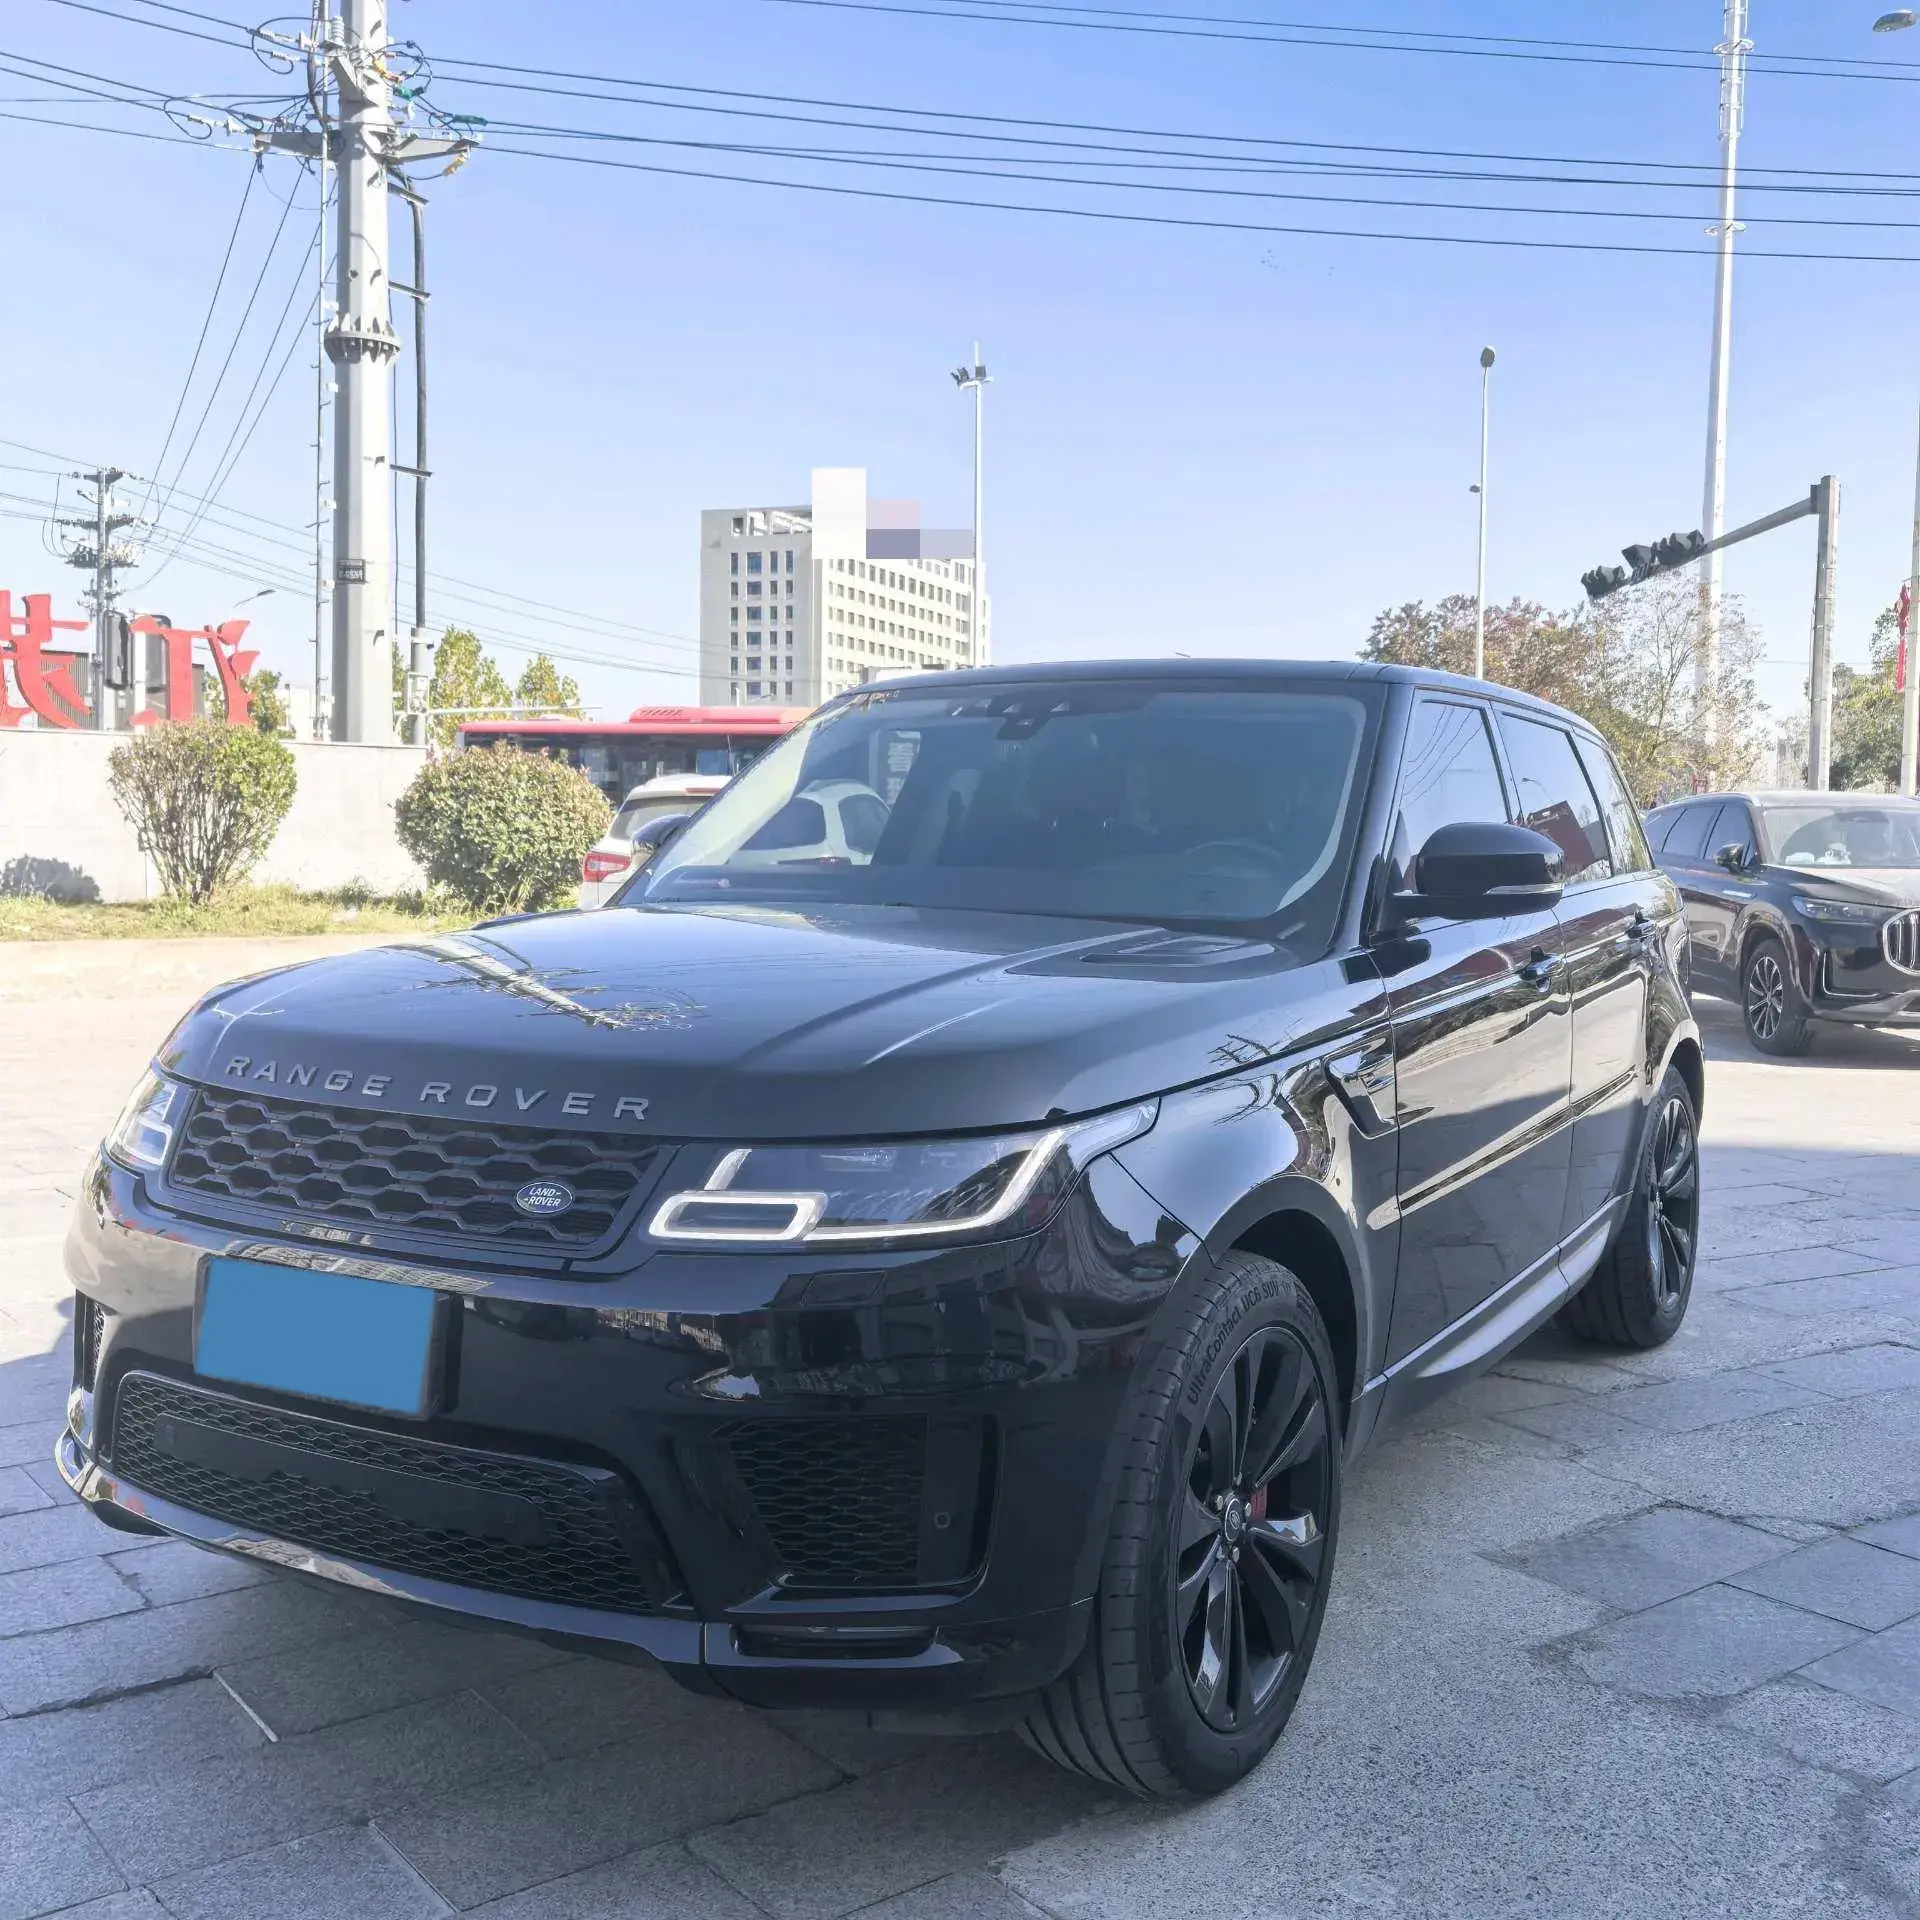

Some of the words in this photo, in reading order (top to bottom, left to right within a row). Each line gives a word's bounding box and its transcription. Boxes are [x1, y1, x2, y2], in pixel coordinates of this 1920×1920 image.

[225, 1055, 393, 1097] RANGE
[420, 1081, 650, 1121] ROVER
[528, 1196, 561, 1207] ROVER
[529, 1187, 557, 1196] LAND
[1186, 1305, 1242, 1405] UltraContact
[1241, 1286, 1262, 1312] UC6
[1262, 1279, 1280, 1299] SUV
